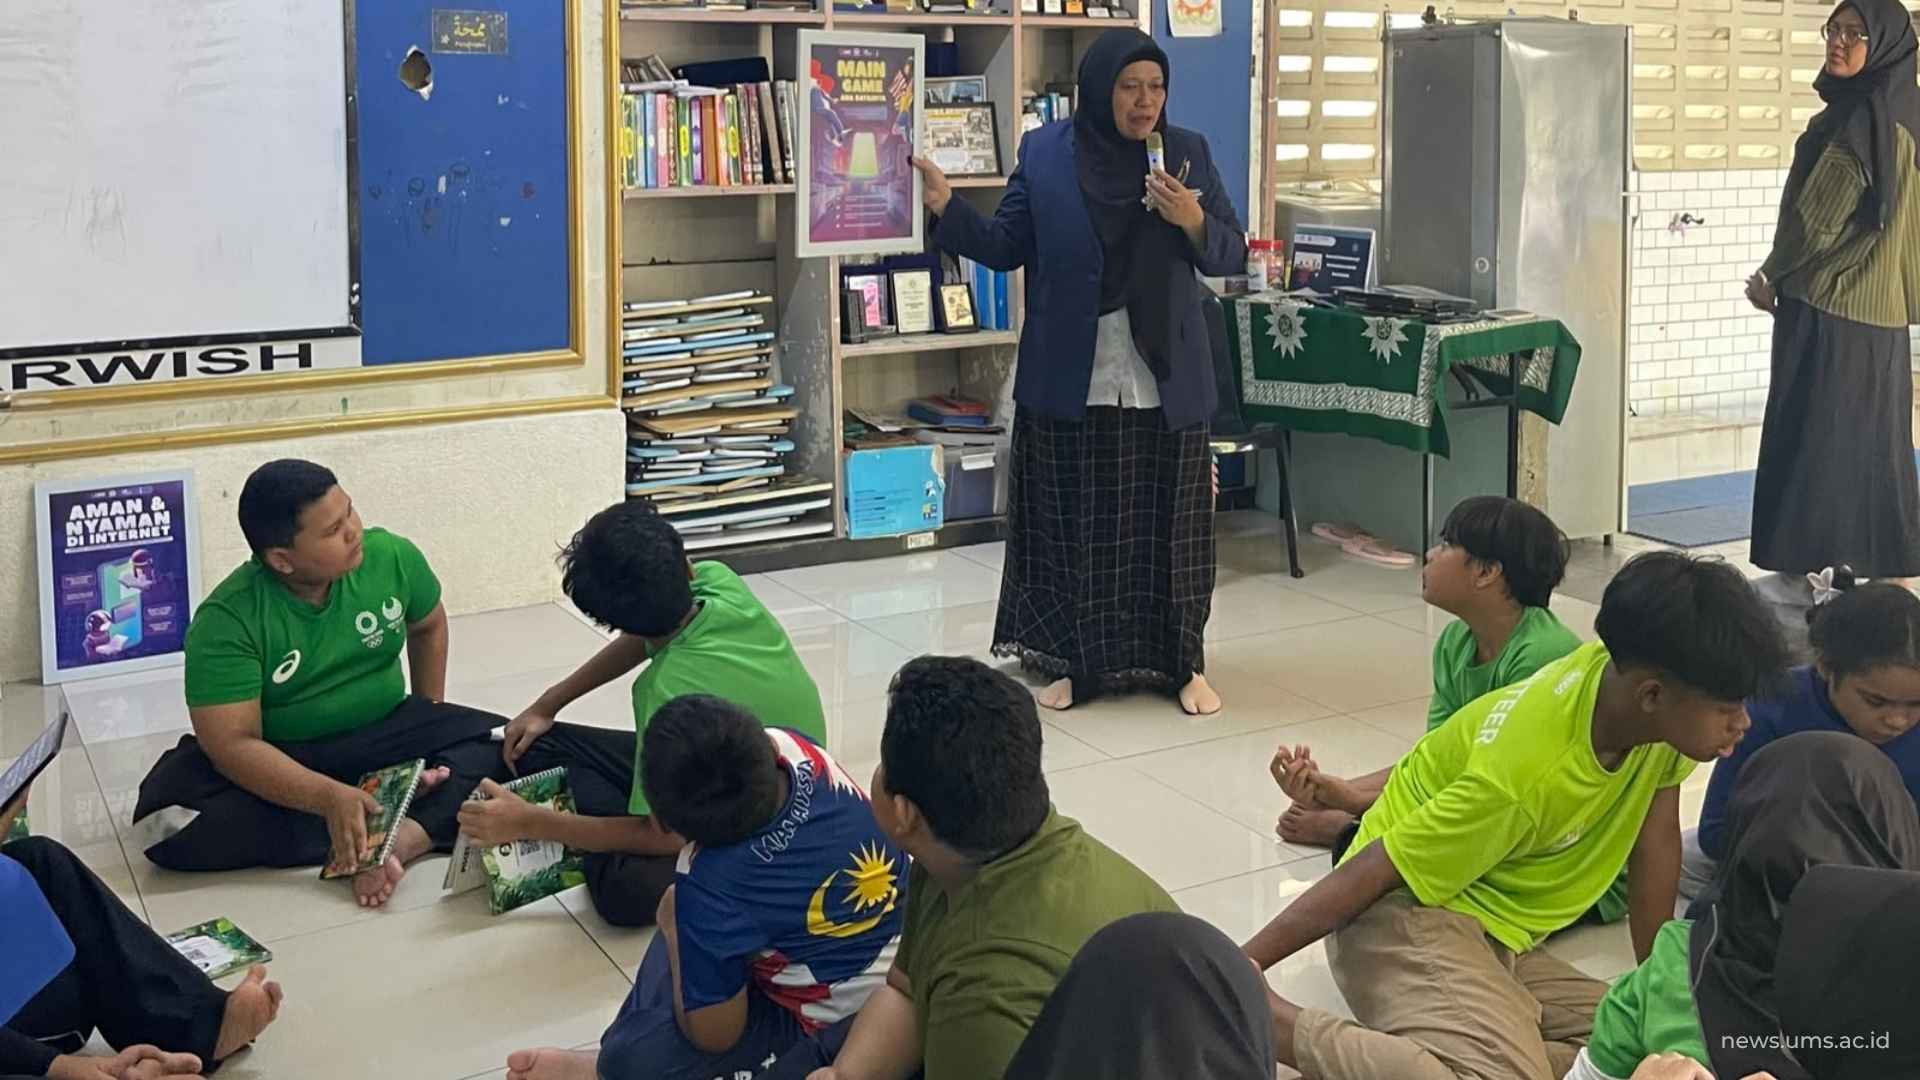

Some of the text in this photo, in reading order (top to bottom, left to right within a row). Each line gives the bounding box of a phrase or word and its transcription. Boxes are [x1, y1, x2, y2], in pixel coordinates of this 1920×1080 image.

[837, 60, 886, 78] MAIN
[842, 79, 884, 93] GAME
[0, 343, 312, 392] RWISH
[69, 496, 165, 520] AMAN &
[66, 510, 171, 536] NYAMAN
[67, 535, 84, 547] DI
[89, 525, 171, 544] INTERNET
[1474, 677, 1534, 744] TEER
